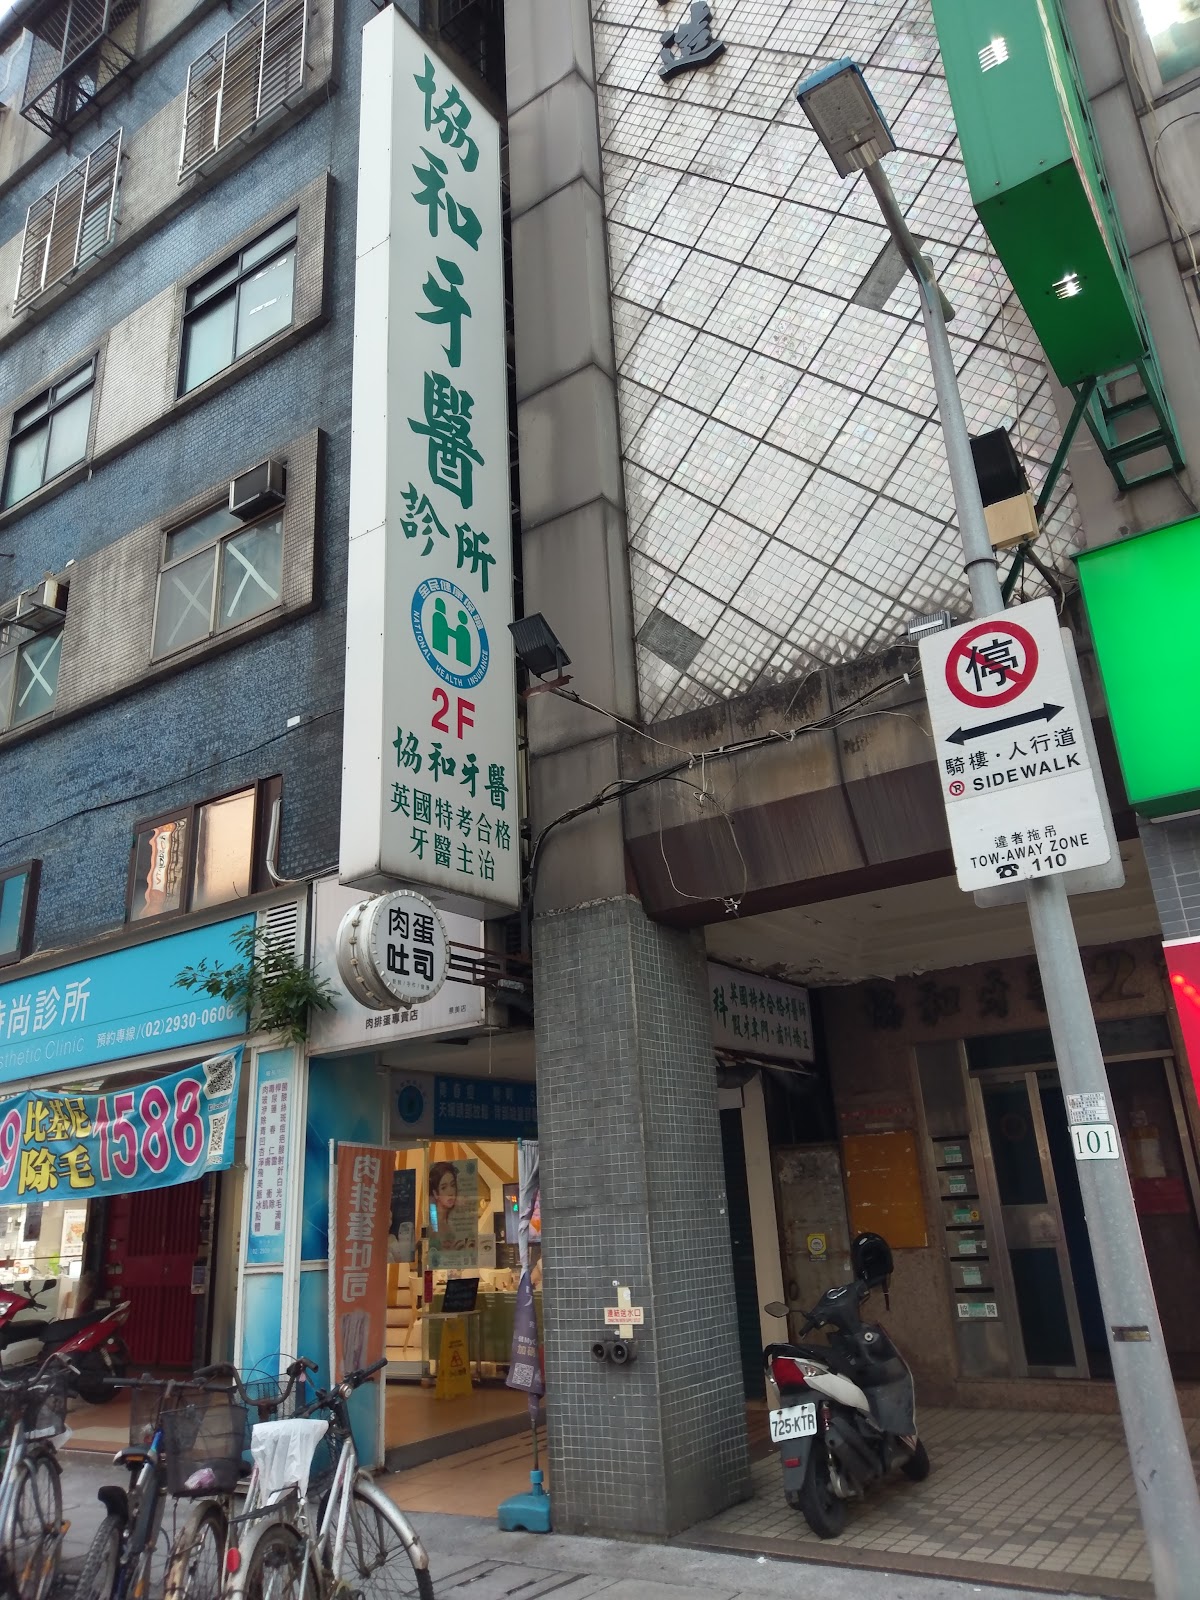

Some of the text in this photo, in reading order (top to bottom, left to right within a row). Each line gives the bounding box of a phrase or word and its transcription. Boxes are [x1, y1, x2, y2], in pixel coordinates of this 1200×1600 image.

[407, 53, 485, 509] 協和牙醫
[398, 481, 497, 593] 診所
[412, 610, 489, 687] NATIONAL HEALTH INSURANCE
[965, 638, 1019, 692] 停
[431, 687, 476, 740] 2F
[393, 725, 510, 812] 協和牙醫
[973, 752, 1082, 792] SIDEWALK
[389, 780, 511, 852] 英國特考合格
[994, 825, 1058, 849] 違者拖吊
[409, 825, 496, 882] 牙醫主治
[970, 832, 1090, 869] TOW-AWAY ZONE
[1031, 853, 1067, 873] 110
[389, 907, 434, 947] 肉蛋
[387, 943, 434, 982] 吐司
[0, 976, 92, 1040] 尚診所
[365, 1009, 419, 1030] 肉排蛋專賣店
[45, 1036, 85, 1060] Clinic
[22, 1096, 93, 1145] 比基尼
[93, 1077, 205, 1183] 1588
[1075, 1130, 1114, 1154] 101
[17, 1146, 96, 1196] 除毛
[771, 1413, 815, 1437] 725-KTR
